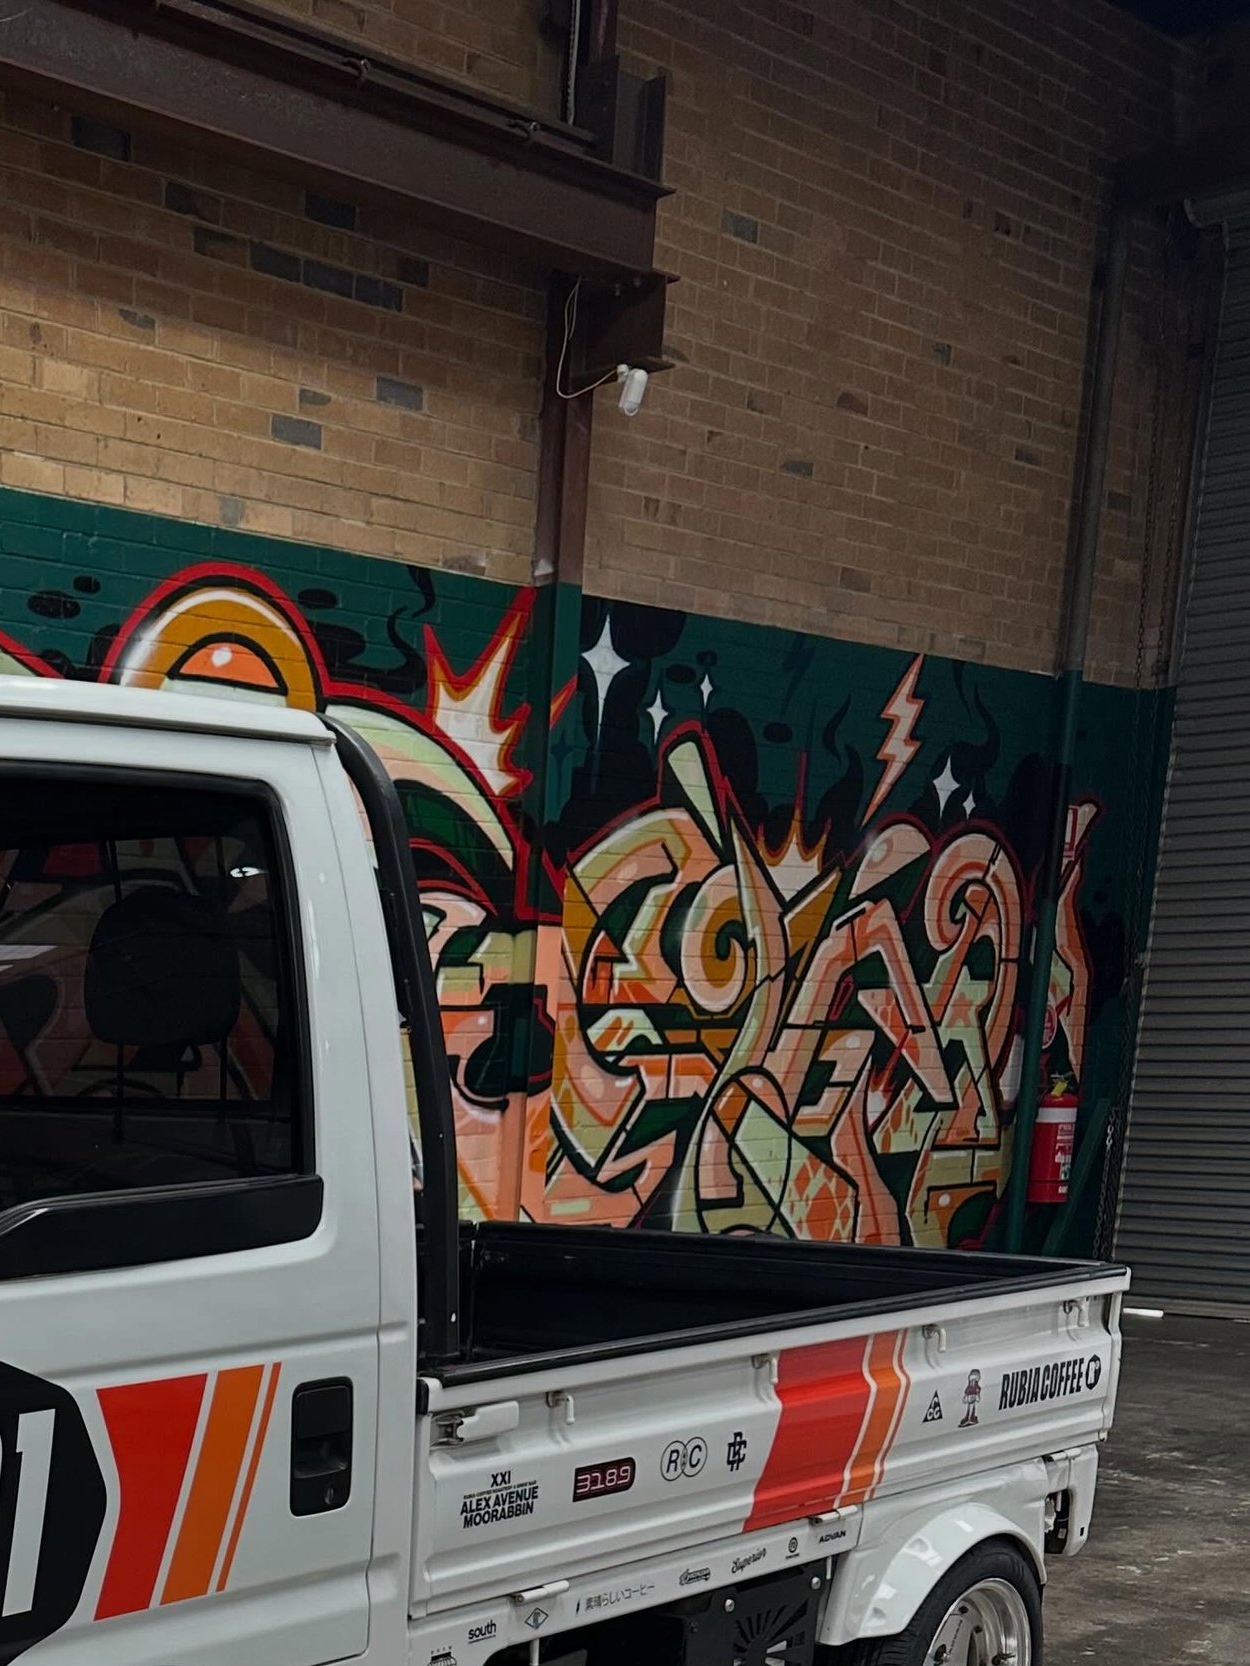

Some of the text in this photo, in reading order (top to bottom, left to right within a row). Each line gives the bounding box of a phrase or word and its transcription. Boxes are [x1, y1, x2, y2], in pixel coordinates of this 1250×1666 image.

[490, 1470, 511, 1488] XXI
[575, 1465, 631, 1493] 3189
[460, 1486, 539, 1516] ALEX AVENUE
[463, 1501, 534, 1528] MOORABBIN
[819, 1530, 847, 1544] ADVAN
[468, 1619, 497, 1640] south
